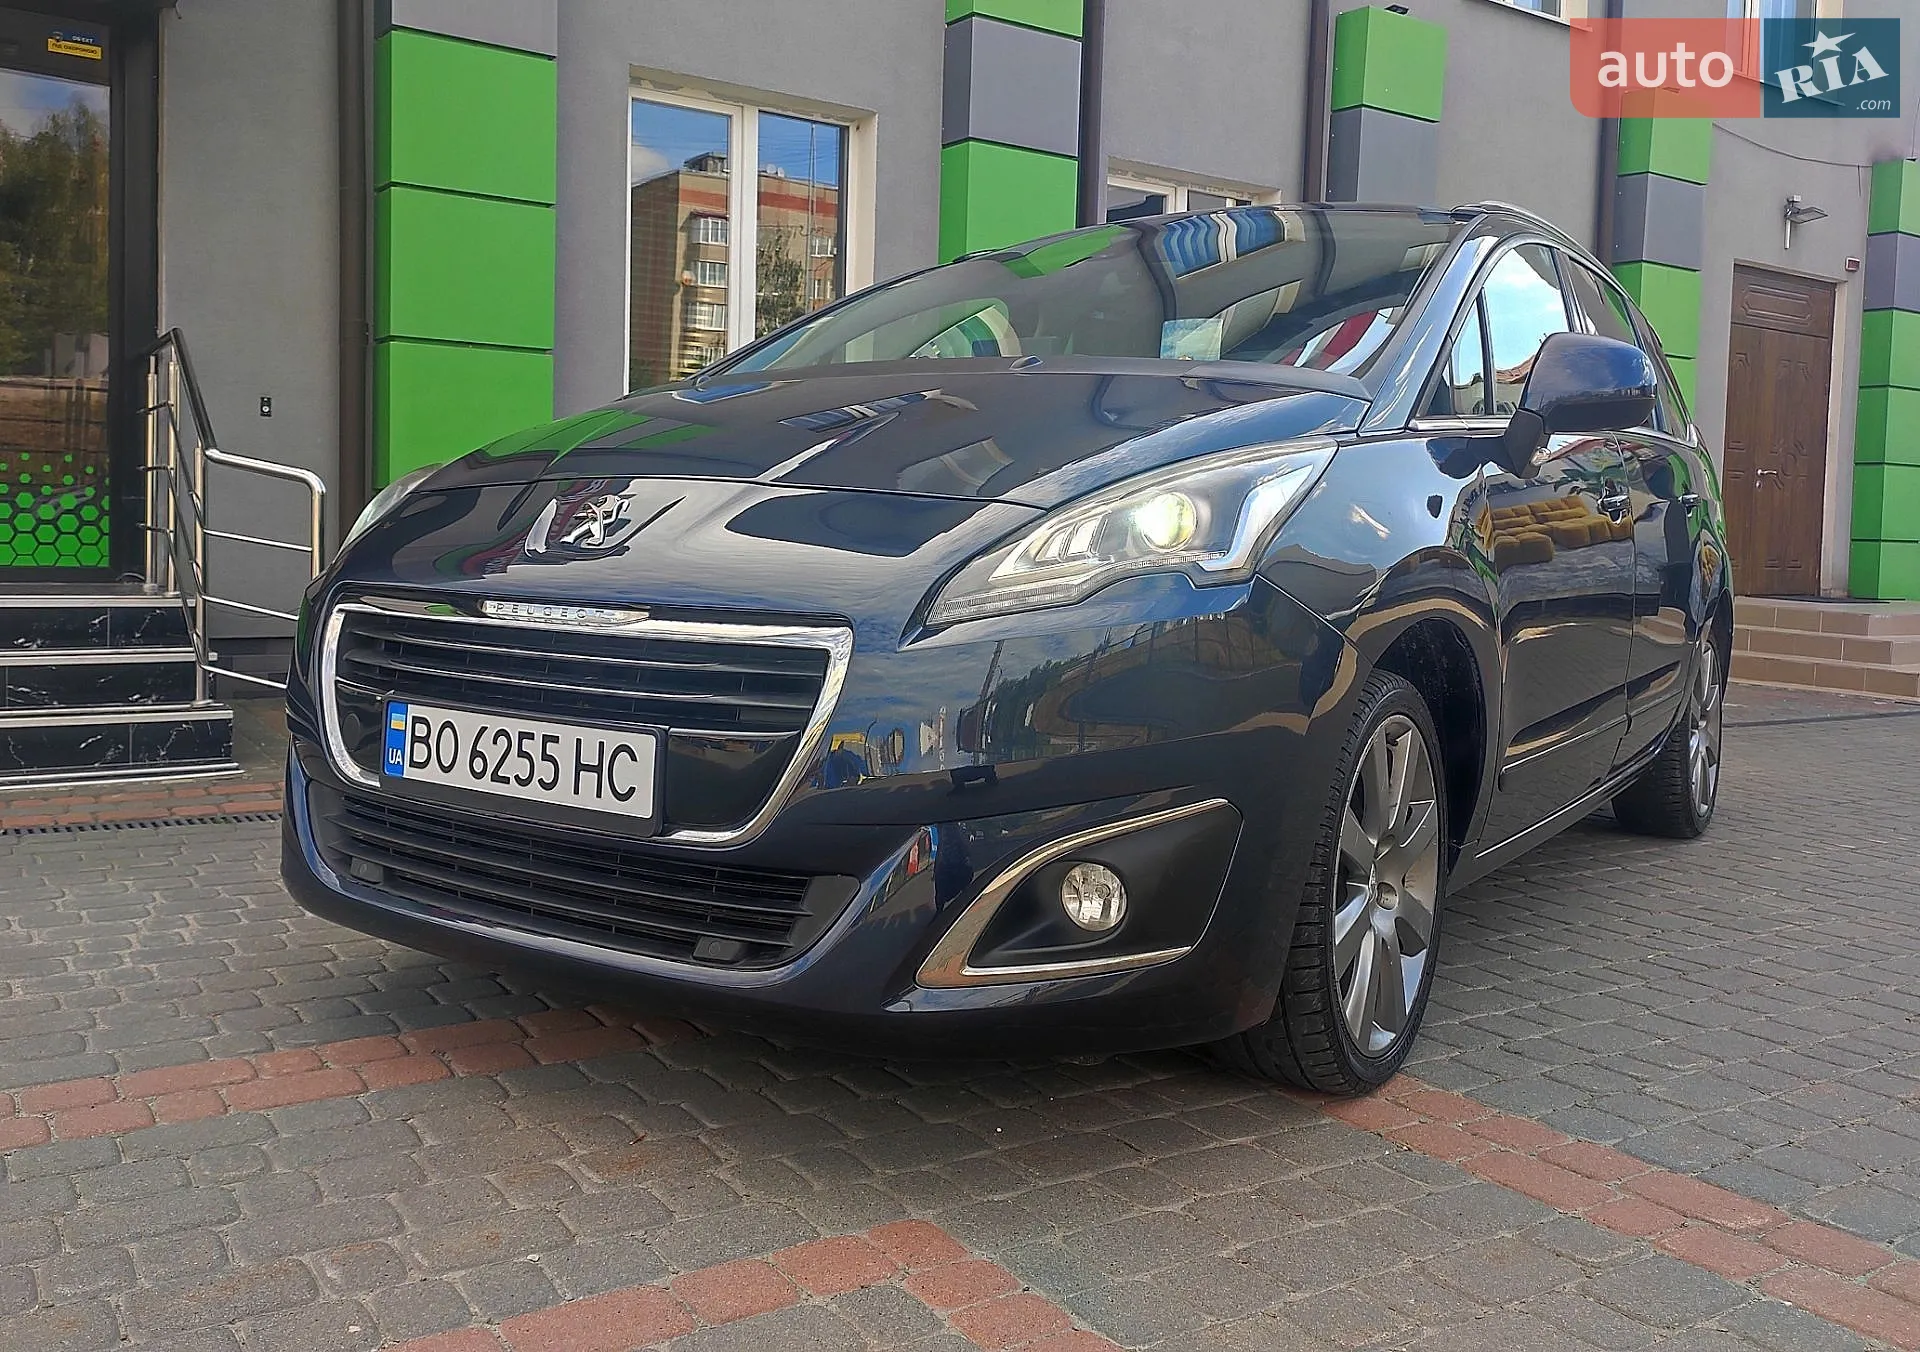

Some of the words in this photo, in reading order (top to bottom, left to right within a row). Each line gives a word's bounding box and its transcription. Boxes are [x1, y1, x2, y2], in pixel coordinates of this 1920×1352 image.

[496, 602, 605, 619] PEUGEOT
[388, 748, 403, 766] UA
[408, 715, 460, 774] BO
[468, 726, 560, 791] 6255
[572, 737, 638, 802] HC
